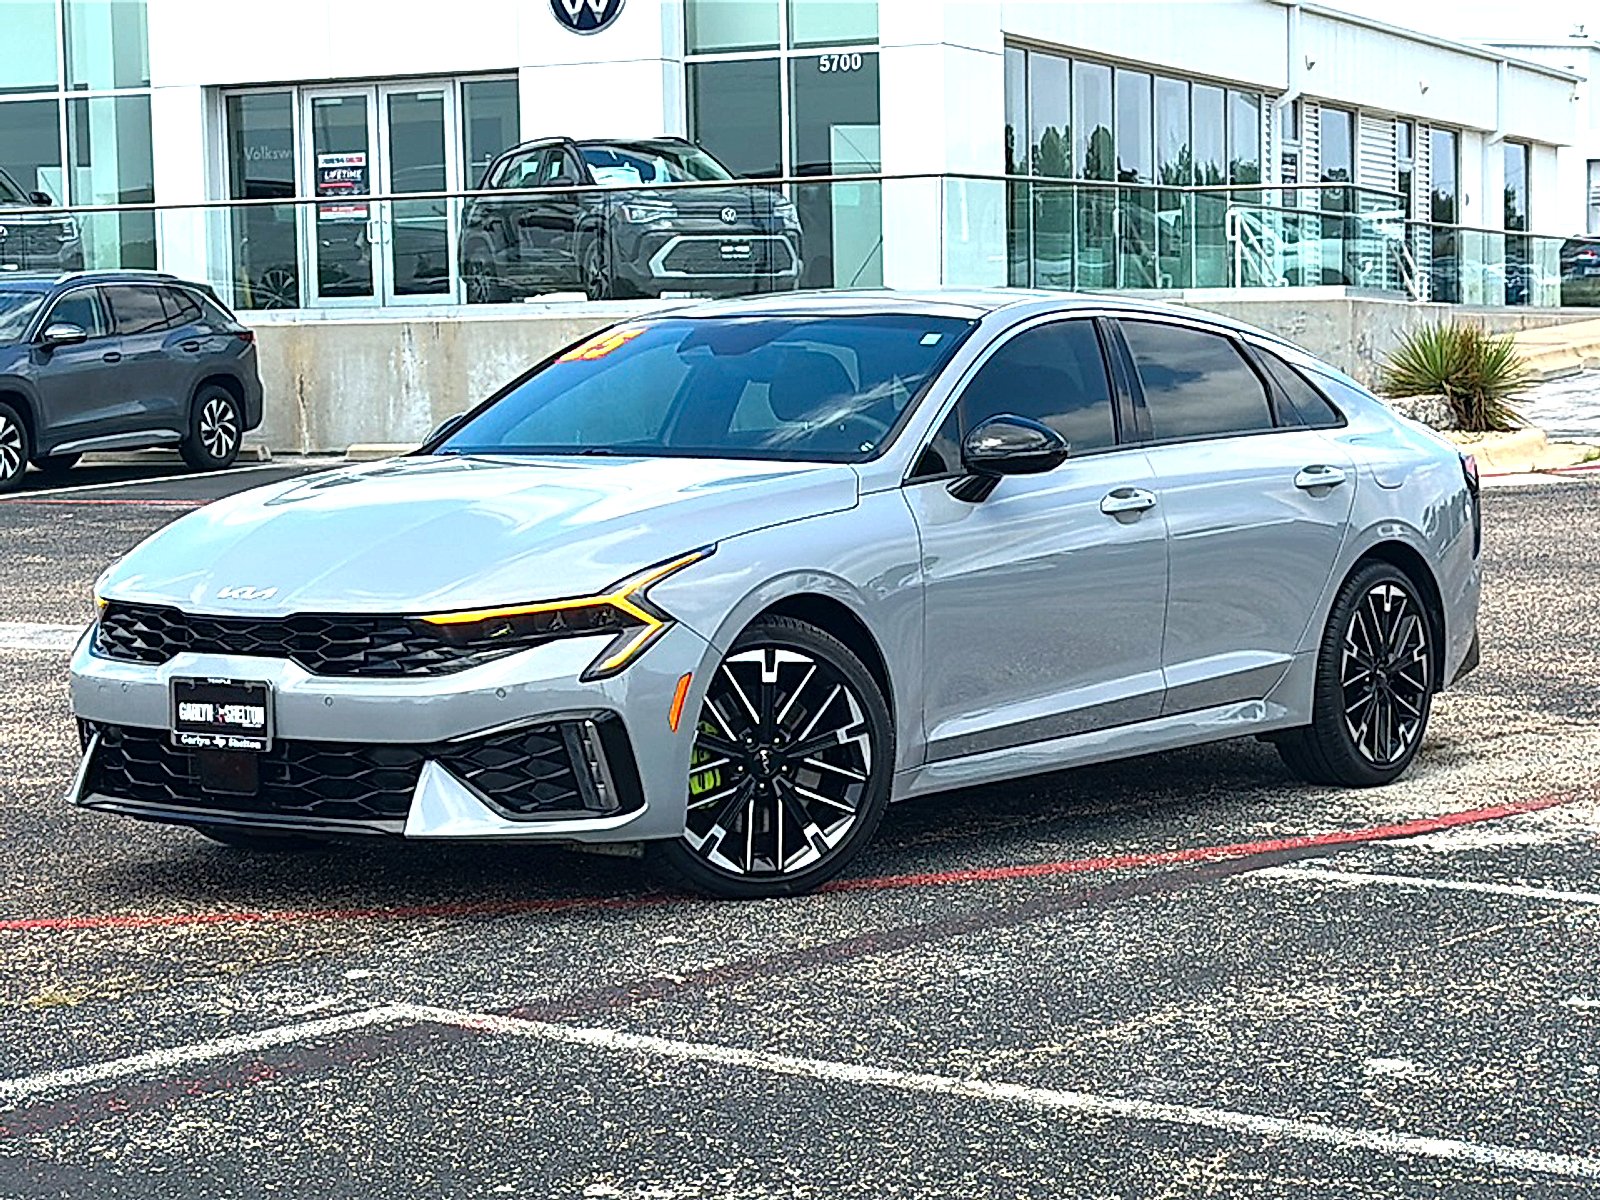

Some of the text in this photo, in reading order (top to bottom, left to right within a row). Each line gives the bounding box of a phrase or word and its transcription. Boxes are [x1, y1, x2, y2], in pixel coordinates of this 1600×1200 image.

[820, 53, 861, 71] 5700
[324, 169, 362, 180] LIFETIME
[216, 585, 279, 600] KIA
[179, 702, 264, 724] GARLYN SHELTON
[228, 738, 261, 749] Shelton
